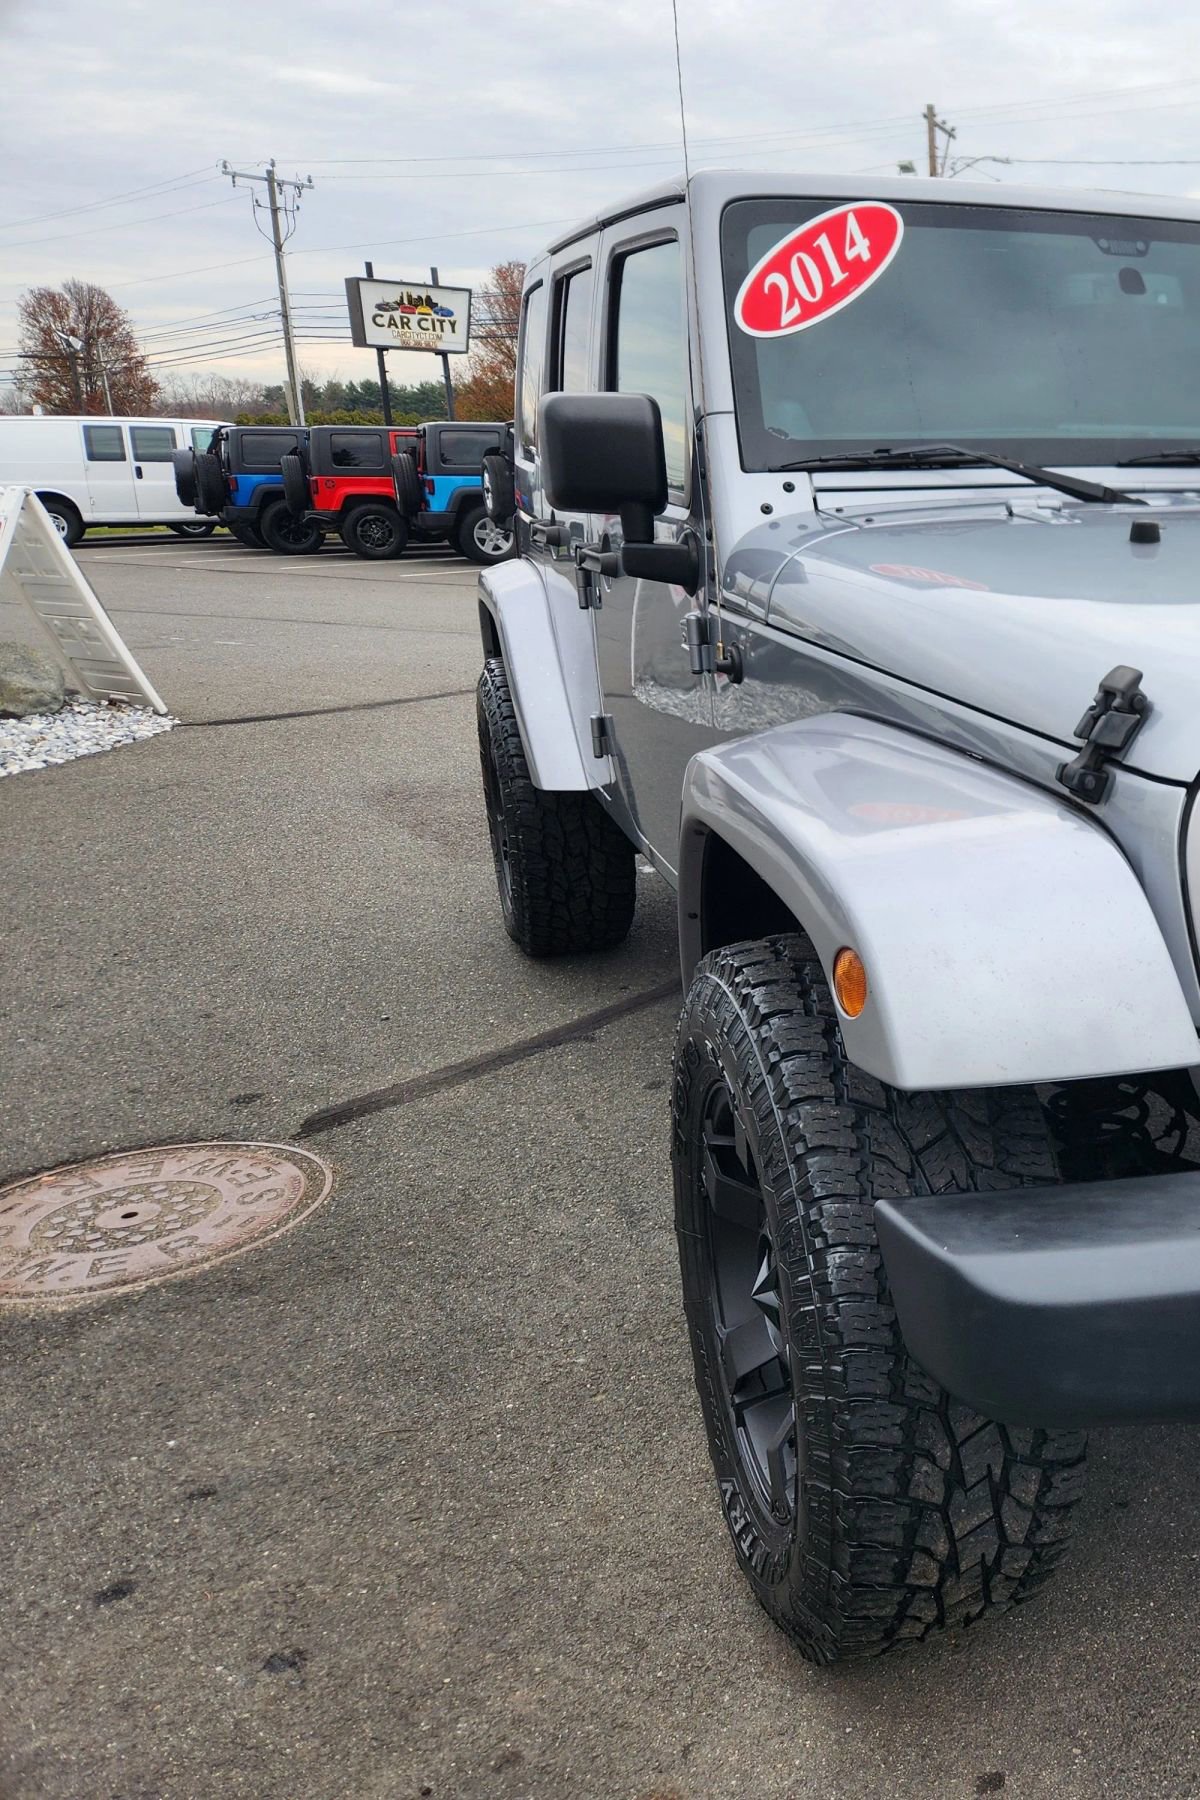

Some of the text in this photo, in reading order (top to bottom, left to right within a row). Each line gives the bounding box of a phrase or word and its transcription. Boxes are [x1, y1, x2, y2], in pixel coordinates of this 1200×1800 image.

[763, 210, 872, 328] 2014
[371, 312, 458, 334] CAR CITY
